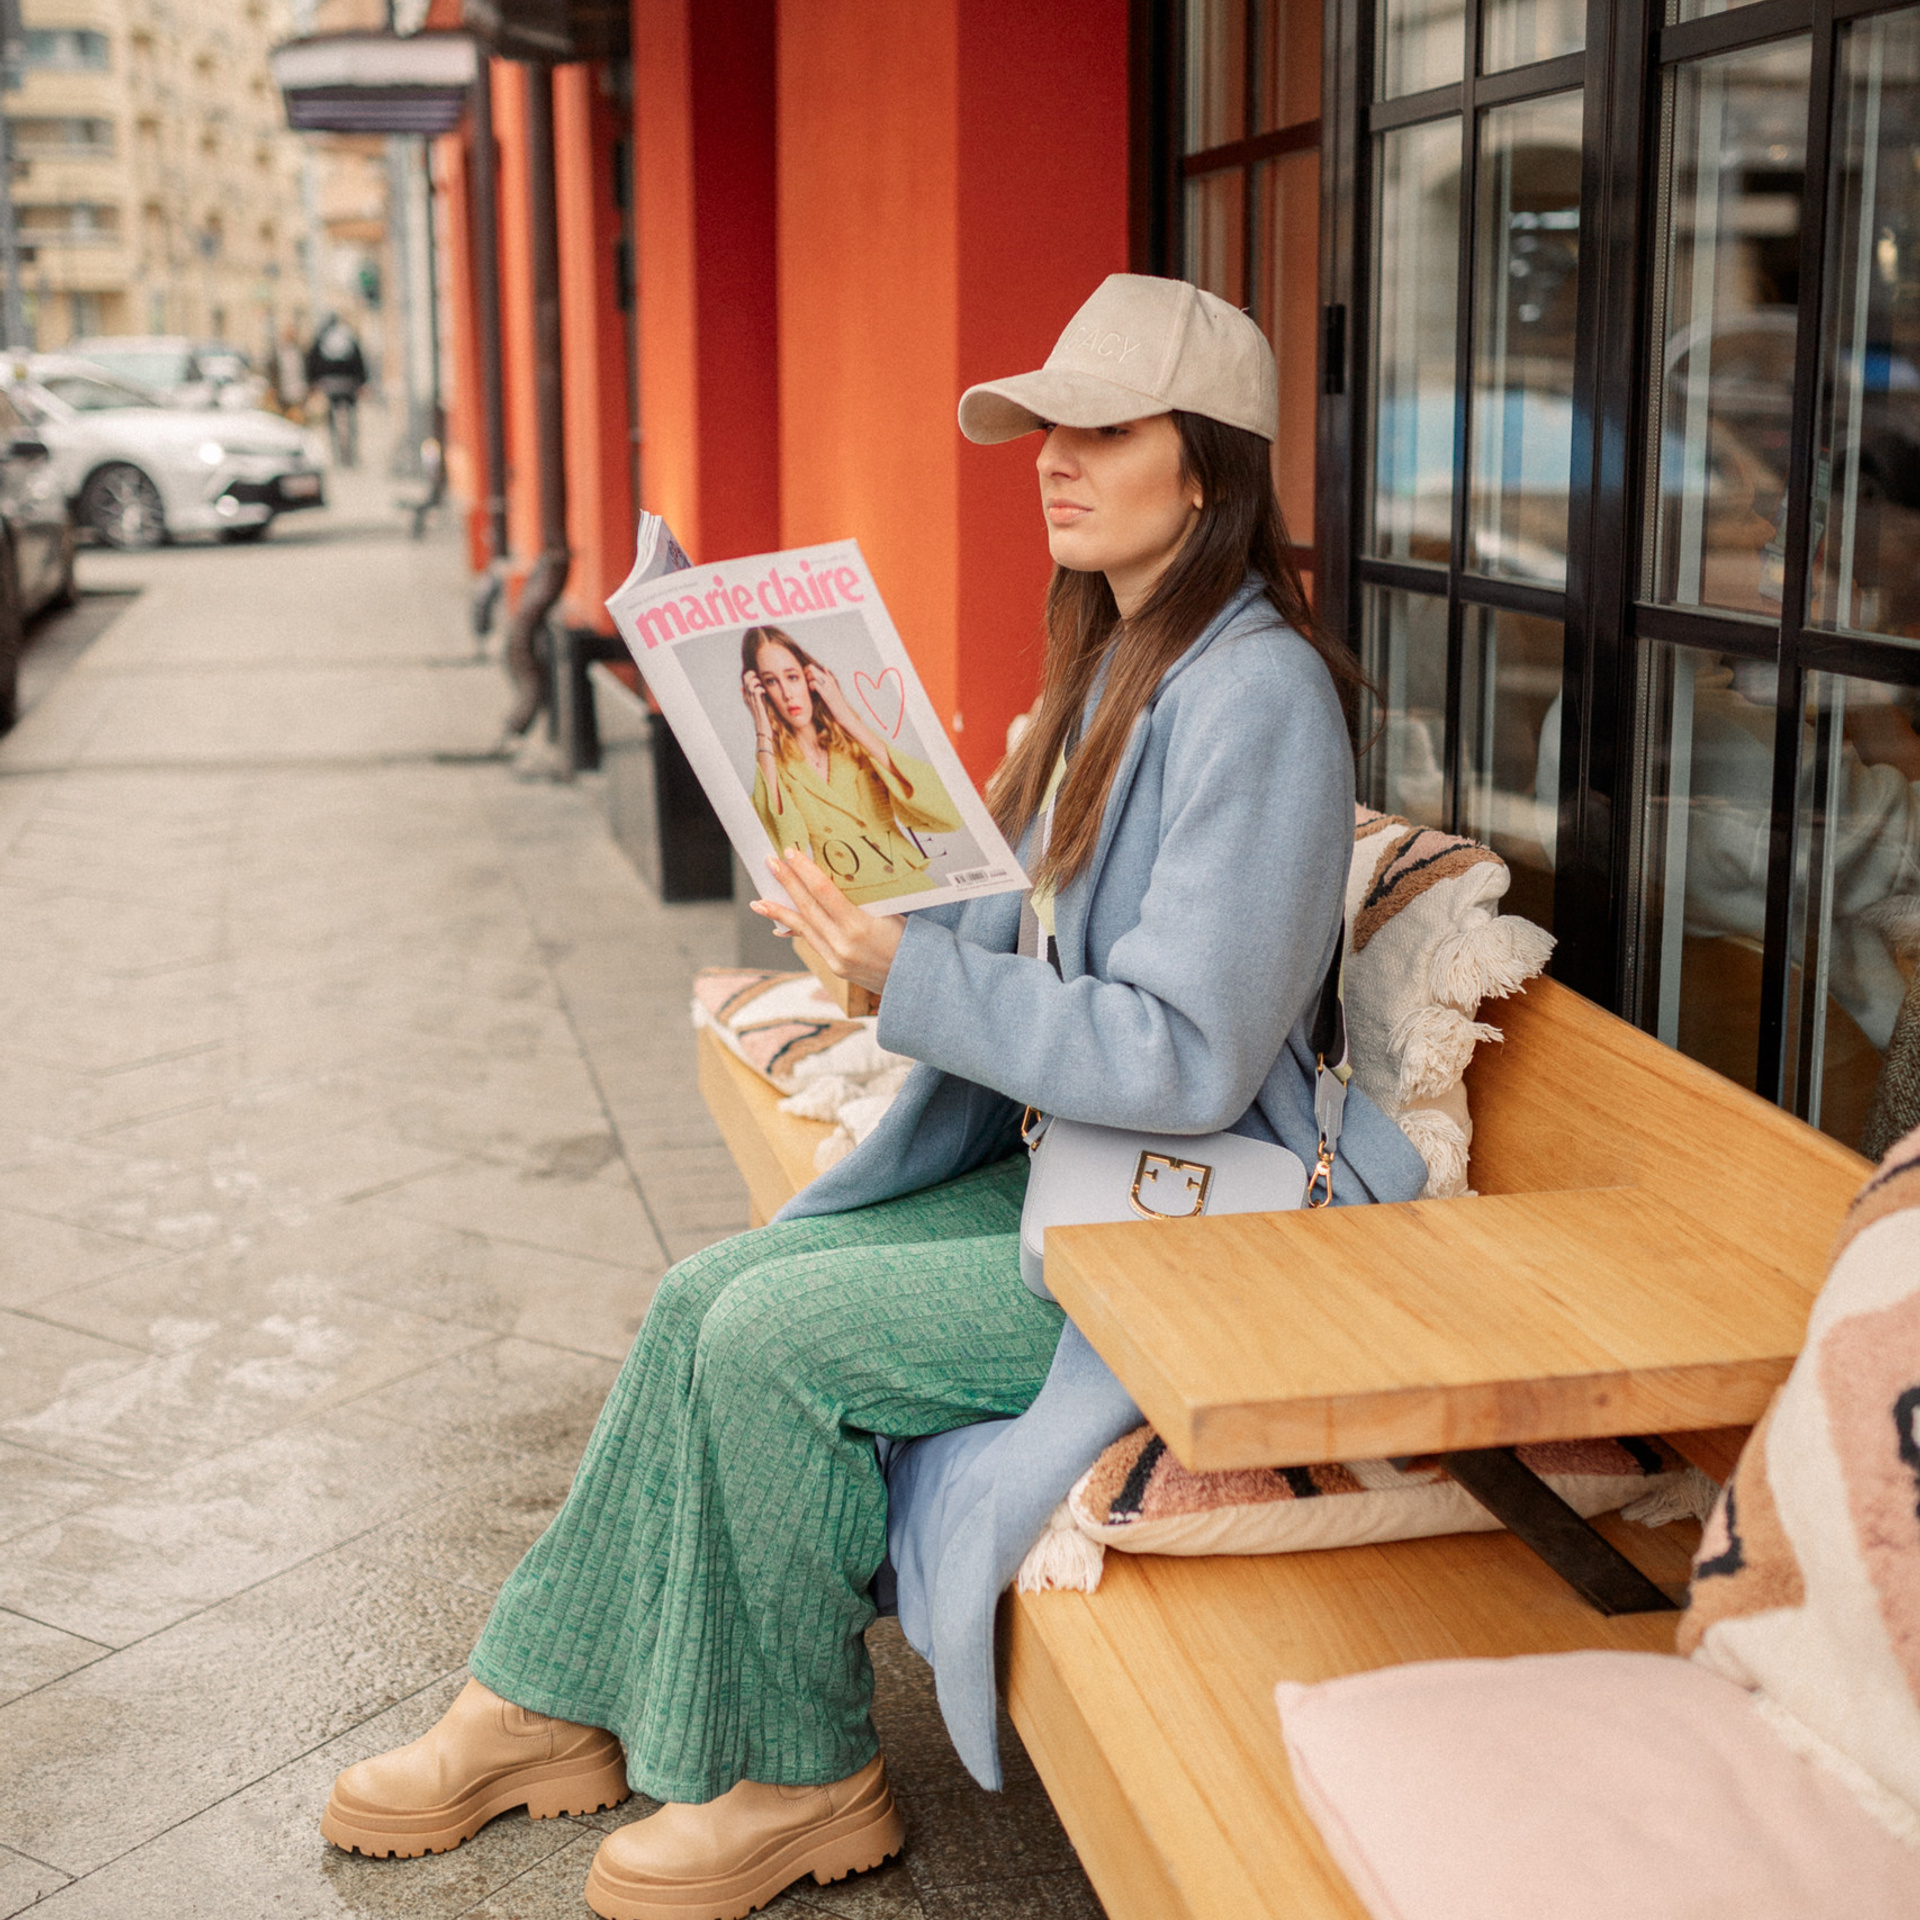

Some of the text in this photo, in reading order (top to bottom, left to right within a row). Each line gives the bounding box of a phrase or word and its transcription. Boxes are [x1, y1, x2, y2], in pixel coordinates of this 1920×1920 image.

[1062, 326, 1141, 364] ACY
[635, 574, 759, 650] marie
[756, 559, 865, 618] claire
[795, 826, 948, 877] OVE
